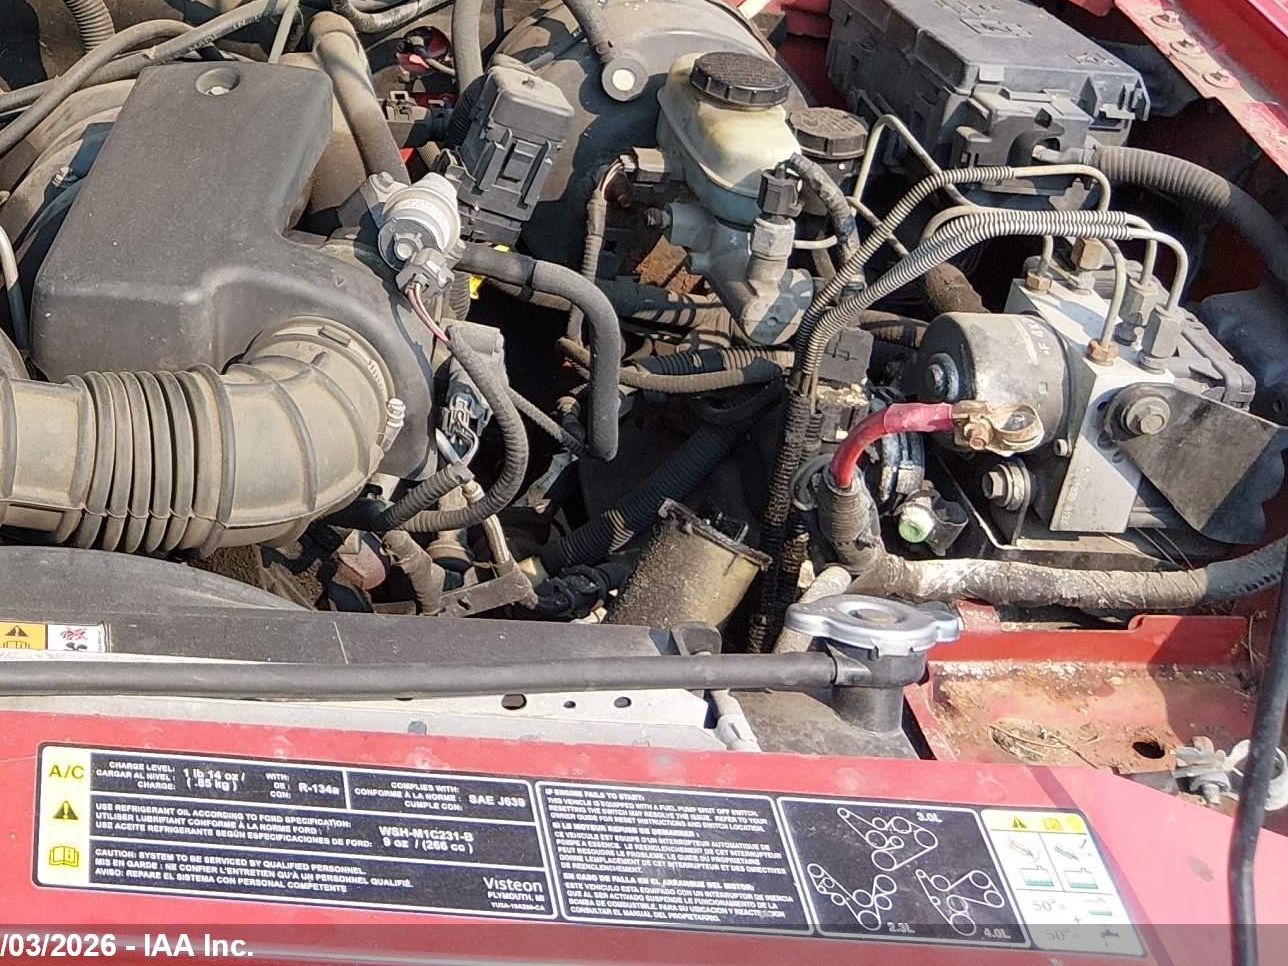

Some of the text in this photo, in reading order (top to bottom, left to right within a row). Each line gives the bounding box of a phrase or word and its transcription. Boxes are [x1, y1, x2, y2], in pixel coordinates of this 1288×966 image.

[49, 764, 85, 779] A/C
[109, 761, 175, 773] CHARGE LEVEL:
[96, 769, 171, 781] CARGAR AL NIVEL
[208, 769, 238, 781] 14 oz
[137, 781, 176, 790] CHARGE:
[298, 782, 340, 795] R-134a
[390, 781, 460, 794] COMPLIES WITH:
[354, 787, 456, 802] CONFORME NORME
[468, 794, 526, 808] SAE J639
[404, 800, 440, 810] CUMPLE
[96, 803, 113, 811] USE
[115, 803, 175, 815] REFRIGERANT
[177, 808, 191, 817] OIL
[192, 809, 244, 821] ACCORDING
[245, 813, 257, 822] TO
[259, 814, 284, 823] FORD
[916, 811, 943, 823] 3.0L
[96, 812, 317, 835] UTILISER LUBRIFIANT CONFORME NORME FORD
[96, 821, 112, 829] USE
[115, 822, 145, 831] ACEITE
[147, 824, 214, 836] REFRIGERANTE
[248, 830, 330, 845] ESPECIFICACIONES
[332, 837, 344, 845] DE
[379, 826, 474, 842] WSH-M1C231-B
[395, 840, 409, 848] oz
[95, 848, 309, 870] CAUTION: SYSTEM TO BE SERVICED BY QUALIFIED
[95, 858, 111, 866] MIS
[113, 859, 125, 867] EN
[126, 860, 158, 870] GARDE
[165, 862, 177, 871] NE
[179, 863, 218, 874] CONFIER
[301, 872, 313, 881] UN
[315, 874, 368, 885] PERSONNEL
[95, 867, 347, 893] AVISO: REPARE EL SISTEMA CON PERSONAL COMPETENTE
[483, 876, 543, 893] Visteon
[887, 922, 916, 934] 2.3L
[984, 927, 1012, 939] 4.0L
